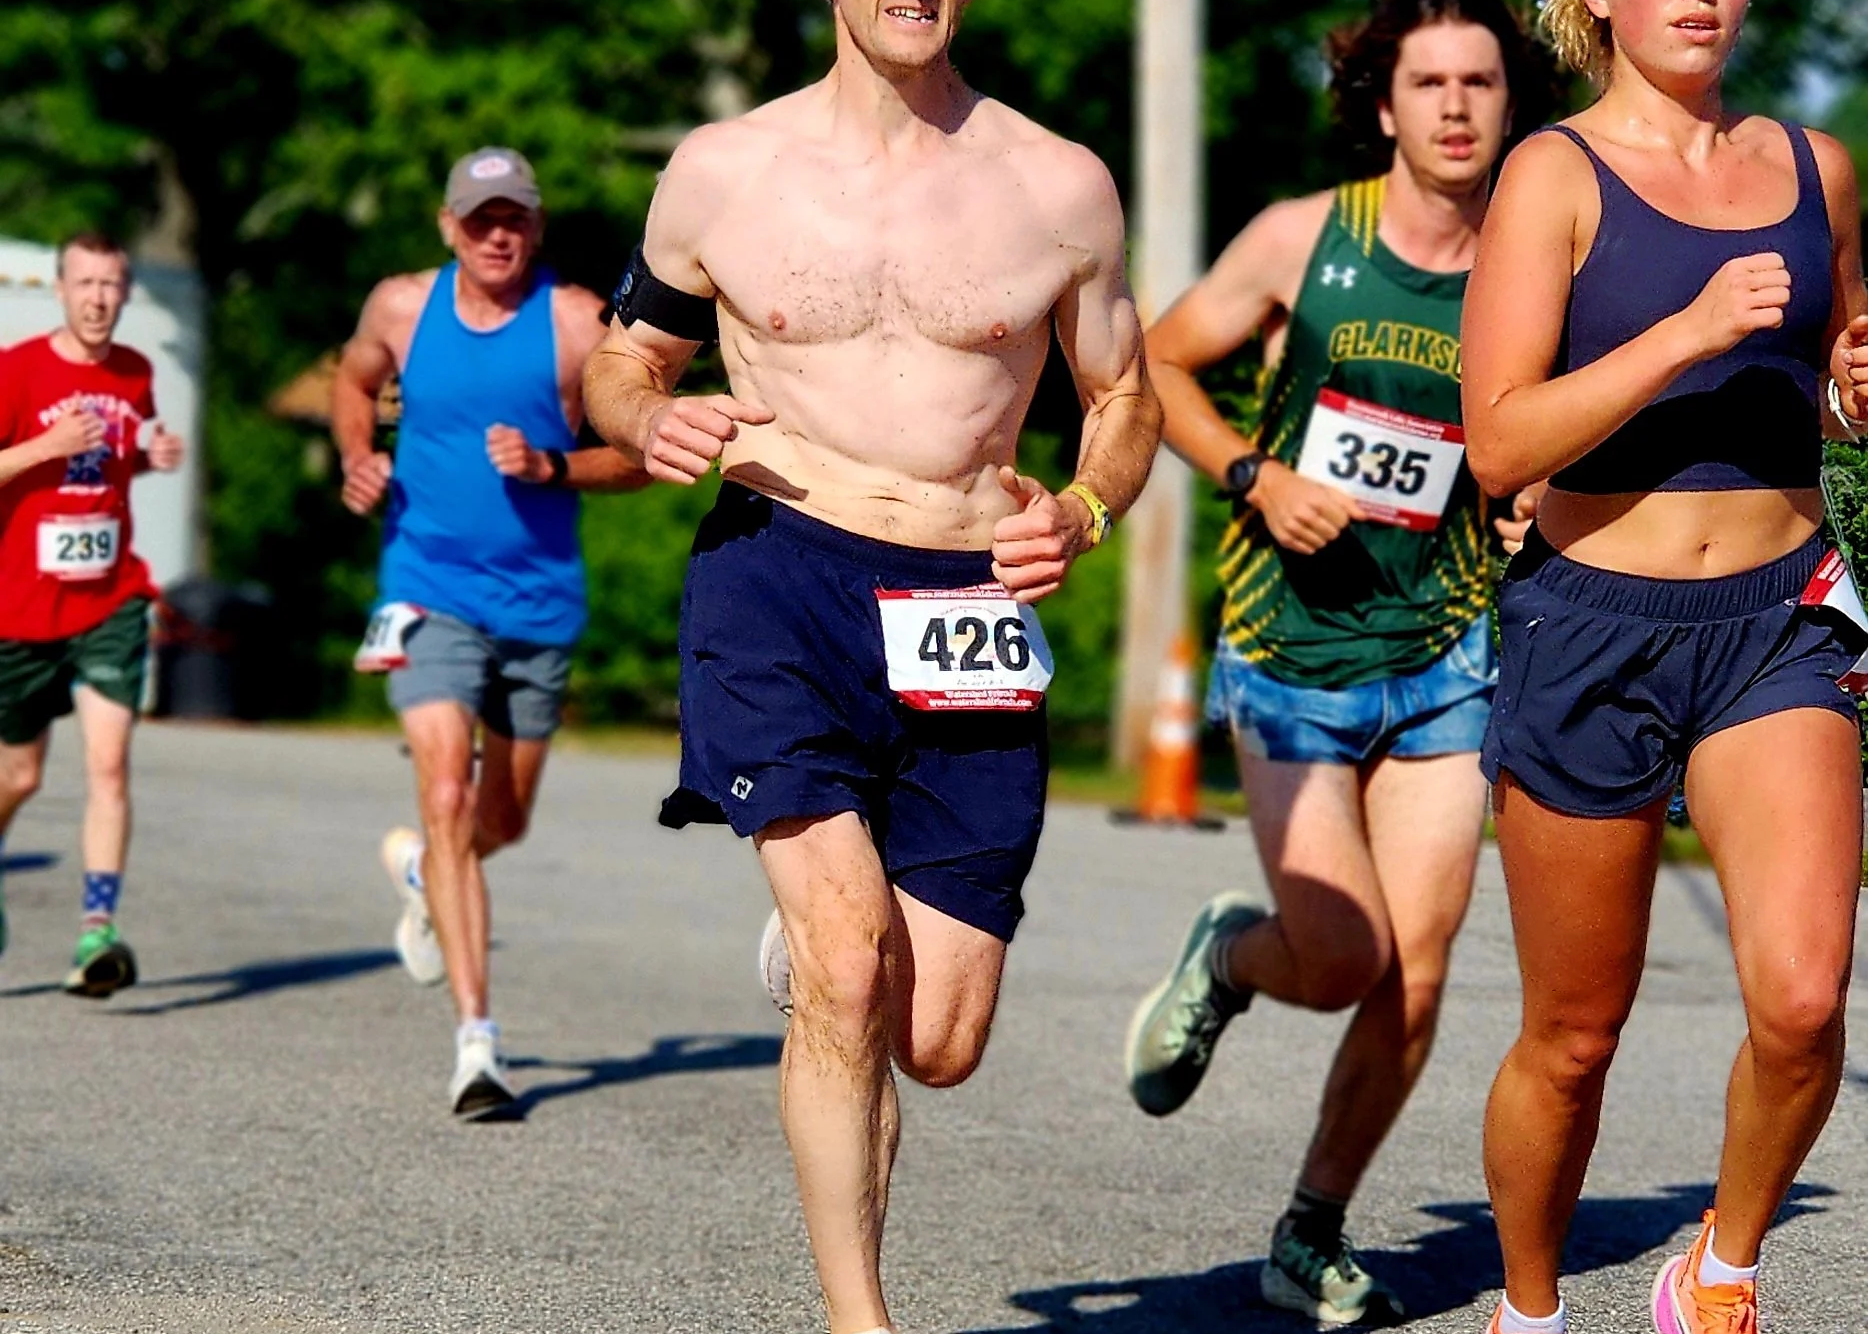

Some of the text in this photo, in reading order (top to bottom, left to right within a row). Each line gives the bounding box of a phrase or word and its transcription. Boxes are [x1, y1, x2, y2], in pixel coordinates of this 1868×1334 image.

[1329, 320, 1462, 383] CLARKS
[1328, 431, 1432, 497] 335
[57, 531, 111, 561] 239
[918, 616, 1030, 672] 426
